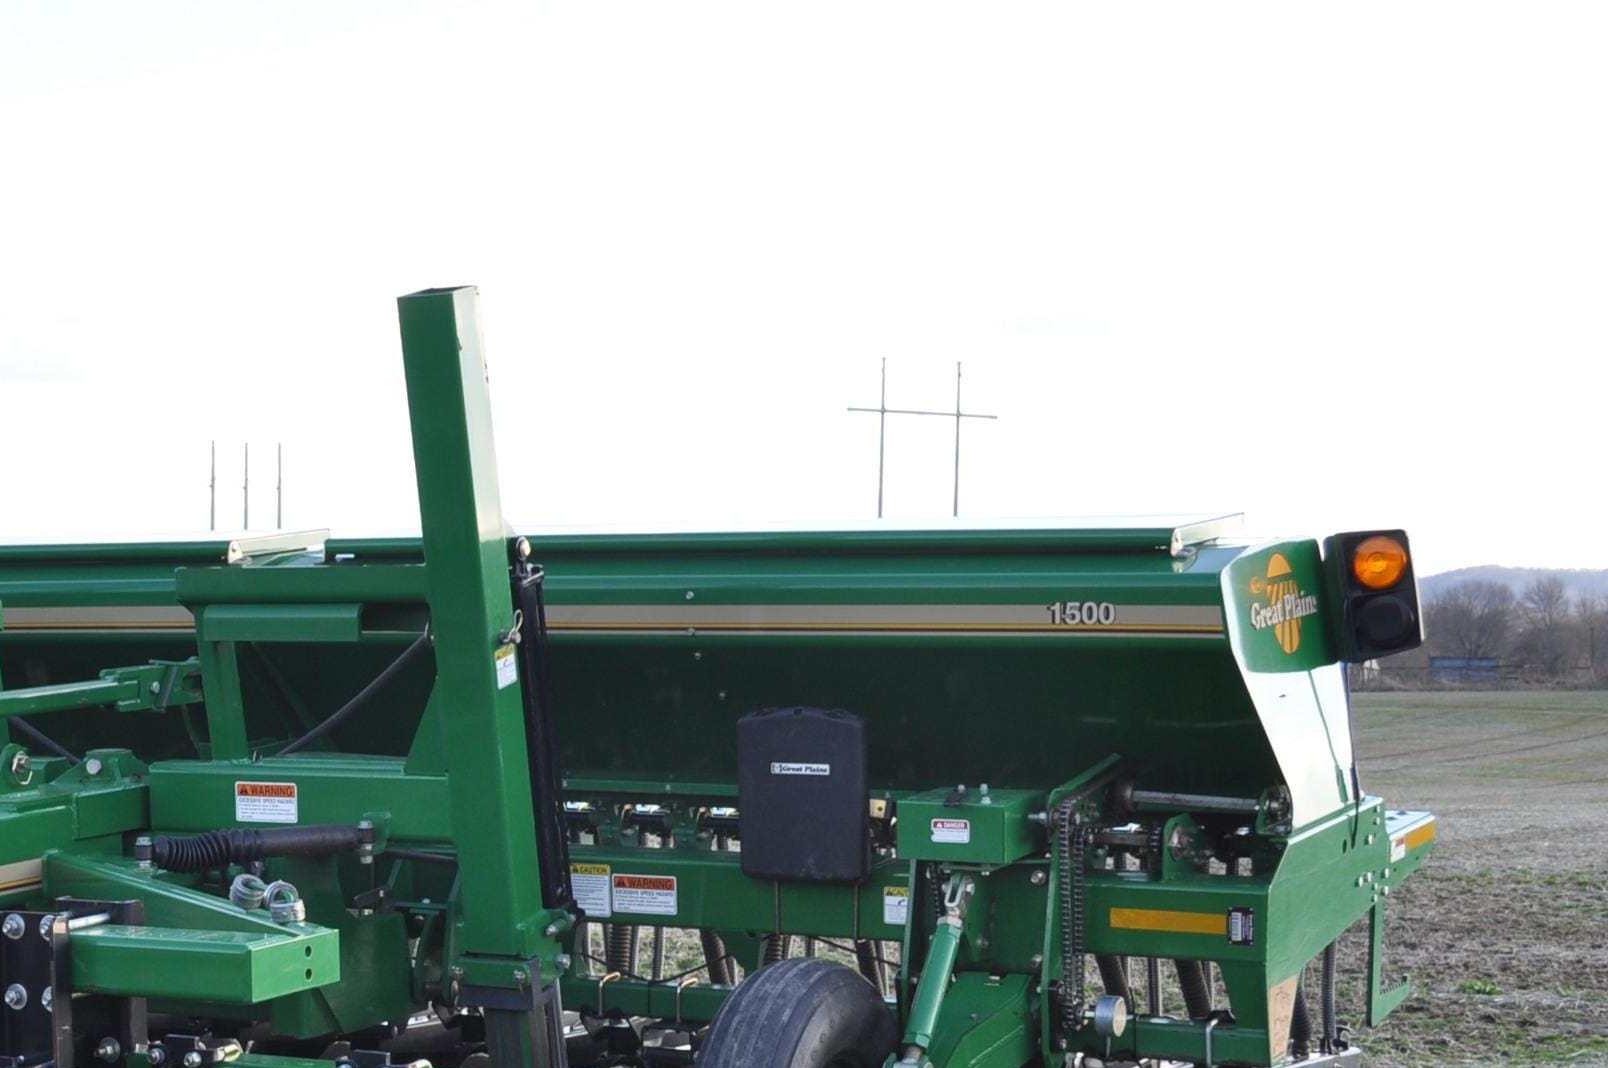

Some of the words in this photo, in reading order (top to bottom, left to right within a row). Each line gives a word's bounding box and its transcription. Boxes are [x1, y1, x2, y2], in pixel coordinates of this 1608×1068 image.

[1050, 601, 1115, 625] 1500
[1251, 600, 1284, 630] Great
[250, 784, 293, 797] WARNING
[579, 866, 608, 874] CAUTION
[630, 877, 673, 890] WARNING
